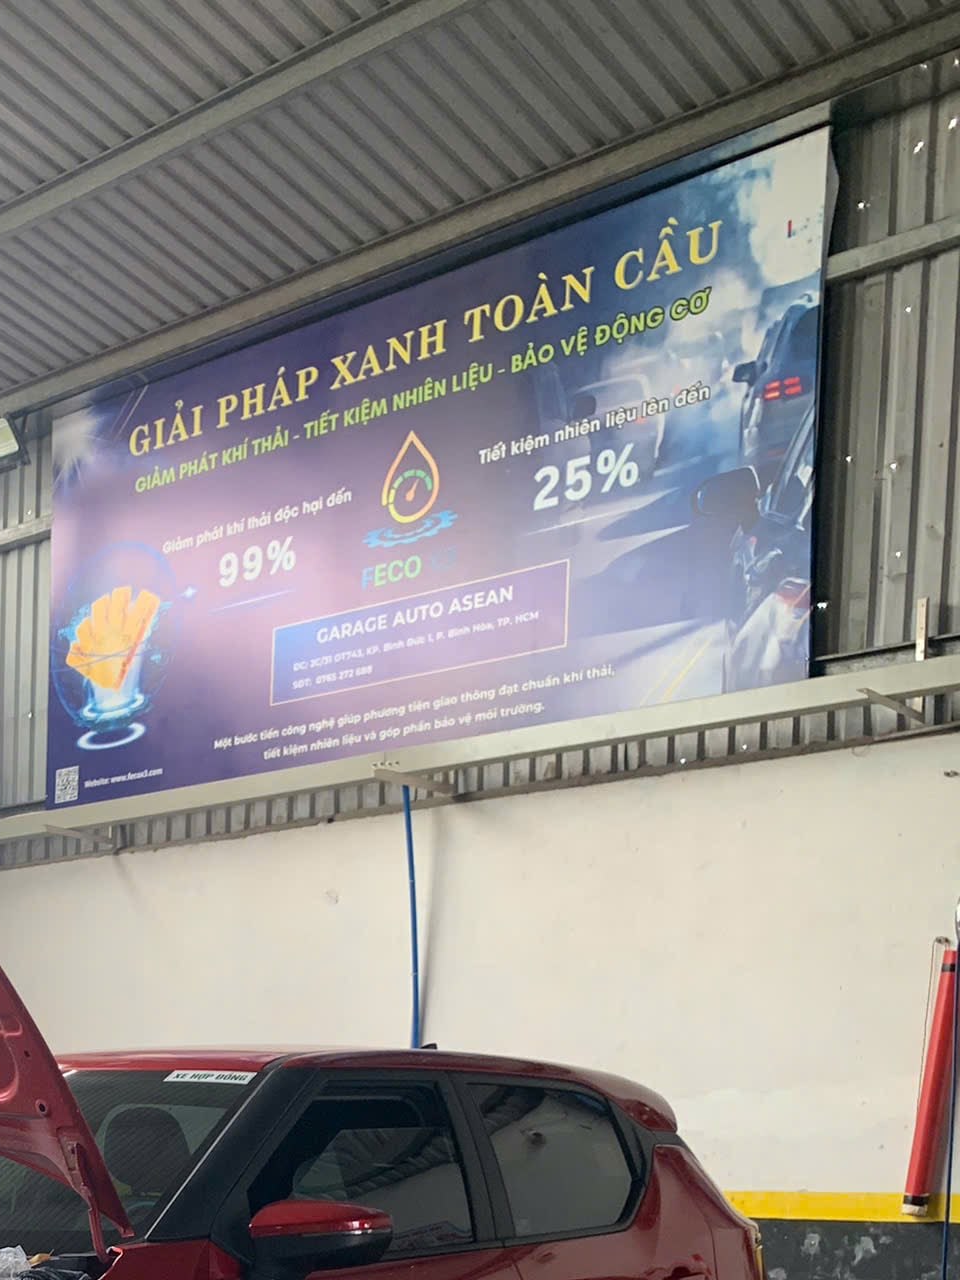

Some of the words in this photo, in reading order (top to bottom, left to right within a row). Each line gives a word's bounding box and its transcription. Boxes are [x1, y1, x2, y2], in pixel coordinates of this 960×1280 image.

[129, 400, 203, 456] GIẢI
[216, 366, 319, 428] PHÁP
[329, 319, 447, 390] XANH
[464, 266, 594, 343] TOÀN
[614, 217, 723, 290] CẦU
[135, 465, 176, 493] GIẢM
[179, 451, 218, 480] PHÁT
[221, 437, 249, 466] KHÍ
[252, 425, 289, 456] THẢI
[304, 409, 339, 440] TIẾT
[344, 398, 388, 427] KIỆM
[393, 377, 447, 411] NHIÊN
[452, 364, 493, 392] LIỆU
[511, 340, 555, 374] BẢO
[560, 327, 588, 357] VỆ
[594, 307, 666, 346] ĐỘNG
[670, 287, 712, 321] CƠ
[479, 442, 506, 465] Tiết
[510, 432, 550, 457] kiệm
[554, 418, 601, 443] nhiên
[605, 407, 638, 430] liệu
[641, 394, 670, 418] lên
[674, 381, 711, 408] đến
[532, 442, 639, 512] 25%
[196, 526, 223, 547] phát
[227, 517, 246, 536] khí
[274, 505, 299, 524] độc
[302, 496, 323, 516] hại
[326, 487, 352, 508] đến
[218, 535, 296, 588] 99%
[361, 554, 422, 590] FECO
[316, 614, 389, 644] GARAGE
[392, 601, 444, 628] AUTO
[448, 584, 514, 615] ASEAN
[213, 737, 233, 750] Một
[260, 727, 279, 741] tiến
[281, 724, 307, 738] công
[308, 718, 334, 735] nghệ
[337, 713, 361, 729] giúp
[363, 704, 406, 723] phương
[408, 699, 430, 713] tiện
[432, 695, 458, 709] giao
[460, 688, 496, 703] thông
[498, 683, 519, 697] đạt
[521, 675, 560, 692] chuẩn
[563, 670, 584, 684] khí
[283, 742, 308, 757] kiệm
[310, 736, 340, 751] nhiên
[342, 733, 362, 747] liệu
[364, 730, 377, 742] và
[379, 726, 401, 742] góp
[434, 714, 456, 728] bảo
[458, 713, 472, 726] vệ
[475, 708, 498, 722] môi
